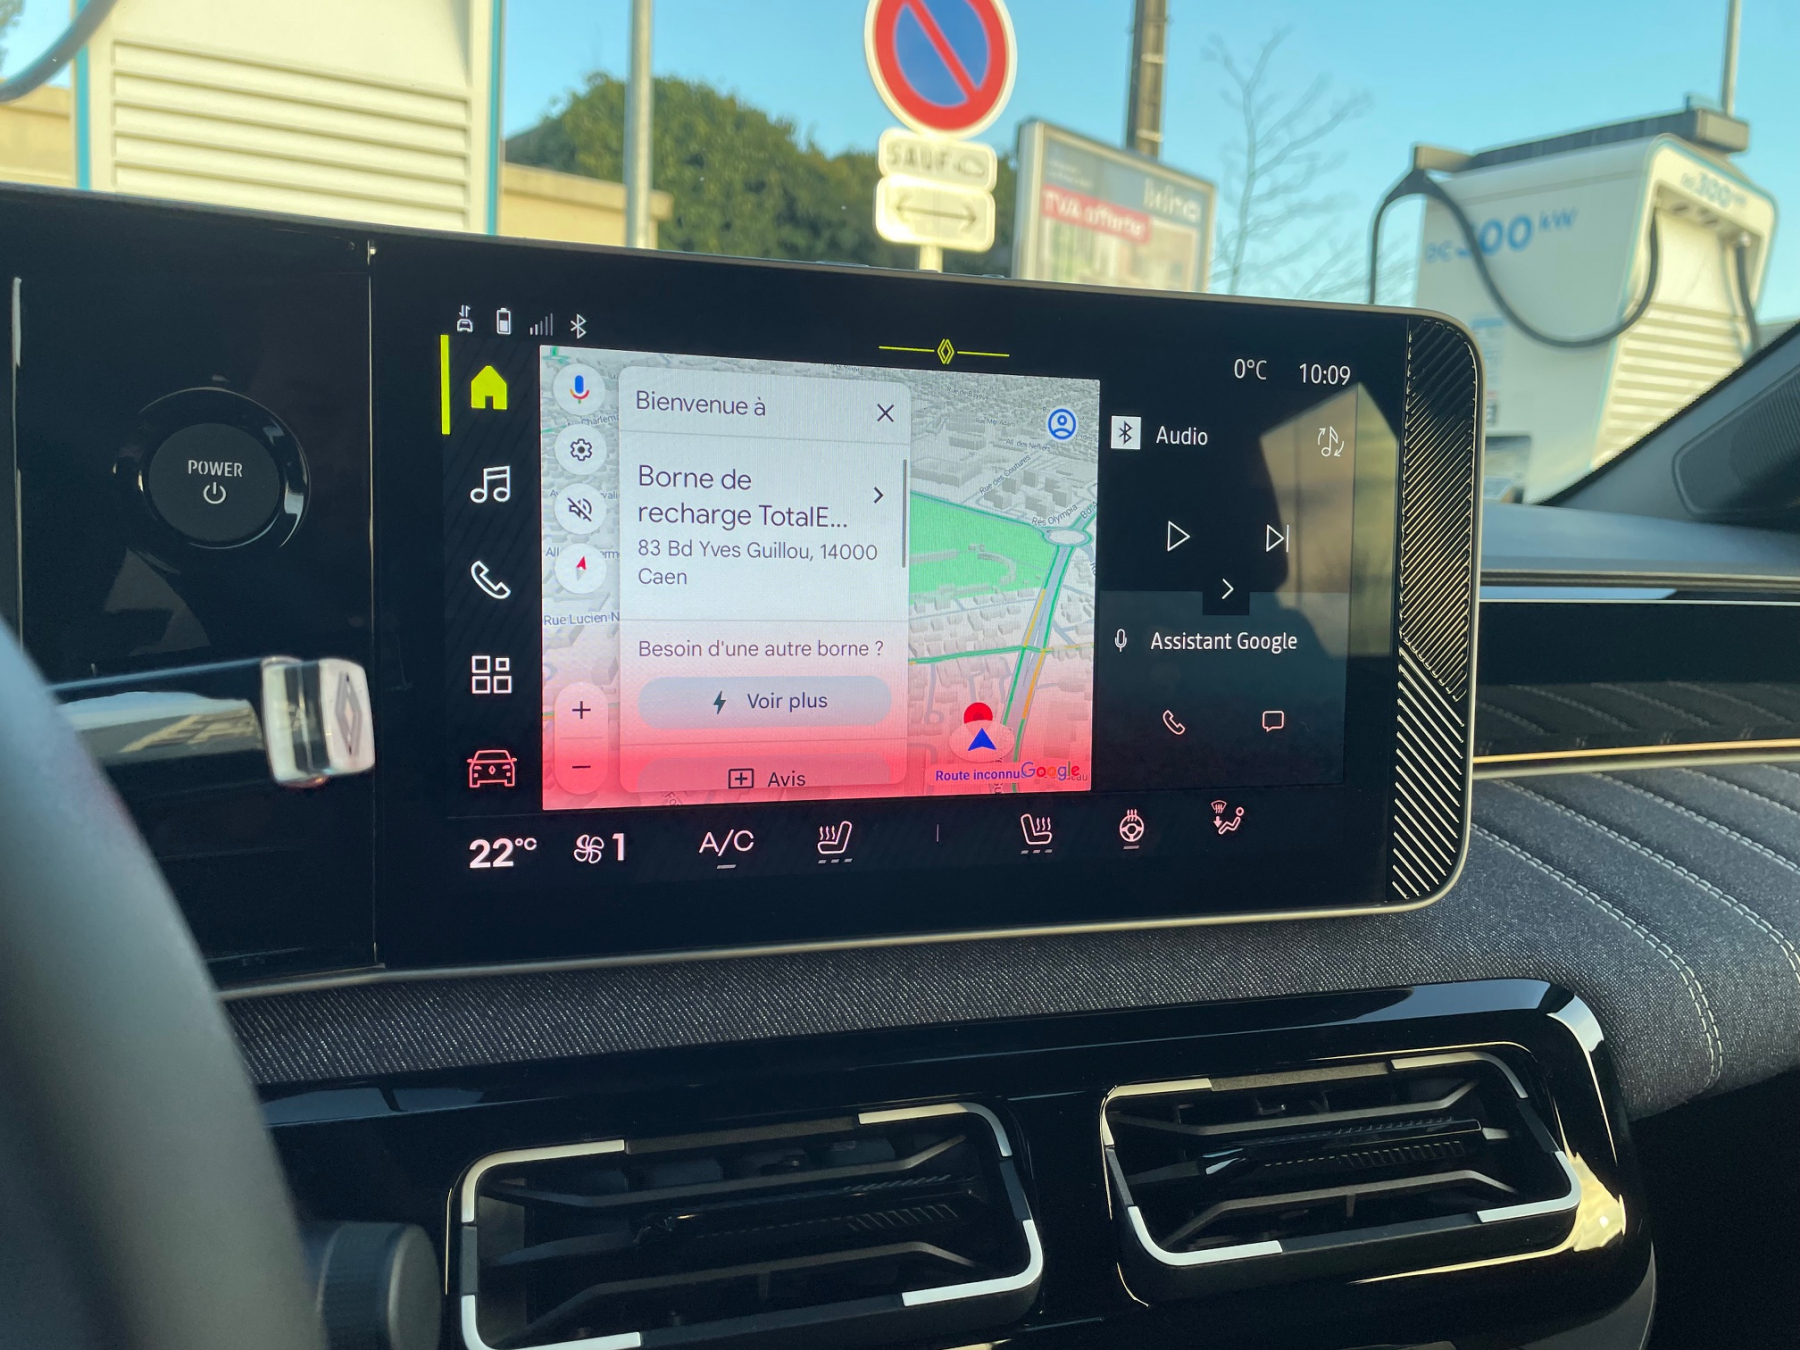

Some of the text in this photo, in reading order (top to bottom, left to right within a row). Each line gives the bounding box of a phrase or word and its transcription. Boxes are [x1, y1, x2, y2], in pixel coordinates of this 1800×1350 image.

[887, 142, 949, 171] SAUF
[1233, 358, 1268, 382] 0°C
[1298, 363, 1352, 387] 10:09
[636, 390, 767, 417] Bienvenue à
[1155, 425, 1209, 447] Audio
[187, 459, 243, 478] POWER
[638, 464, 752, 491] Borne de
[979, 483, 993, 494] Rue
[993, 475, 1005, 486] des
[638, 502, 752, 530] recharge
[638, 540, 878, 561] 83 Bd Yves Guillou, 14000
[637, 568, 688, 586] Caen
[544, 615, 567, 626] Rue
[569, 612, 608, 625] Lucien
[637, 639, 884, 658] Besoin d'une autre borne ?
[1150, 631, 1298, 655] Assistant Google
[746, 692, 829, 715] Voir plus
[766, 769, 807, 788] Avis
[935, 768, 1025, 782] Route inconnu
[1020, 760, 1081, 781] Google
[612, 832, 627, 861] 1
[698, 829, 756, 858] A/C
